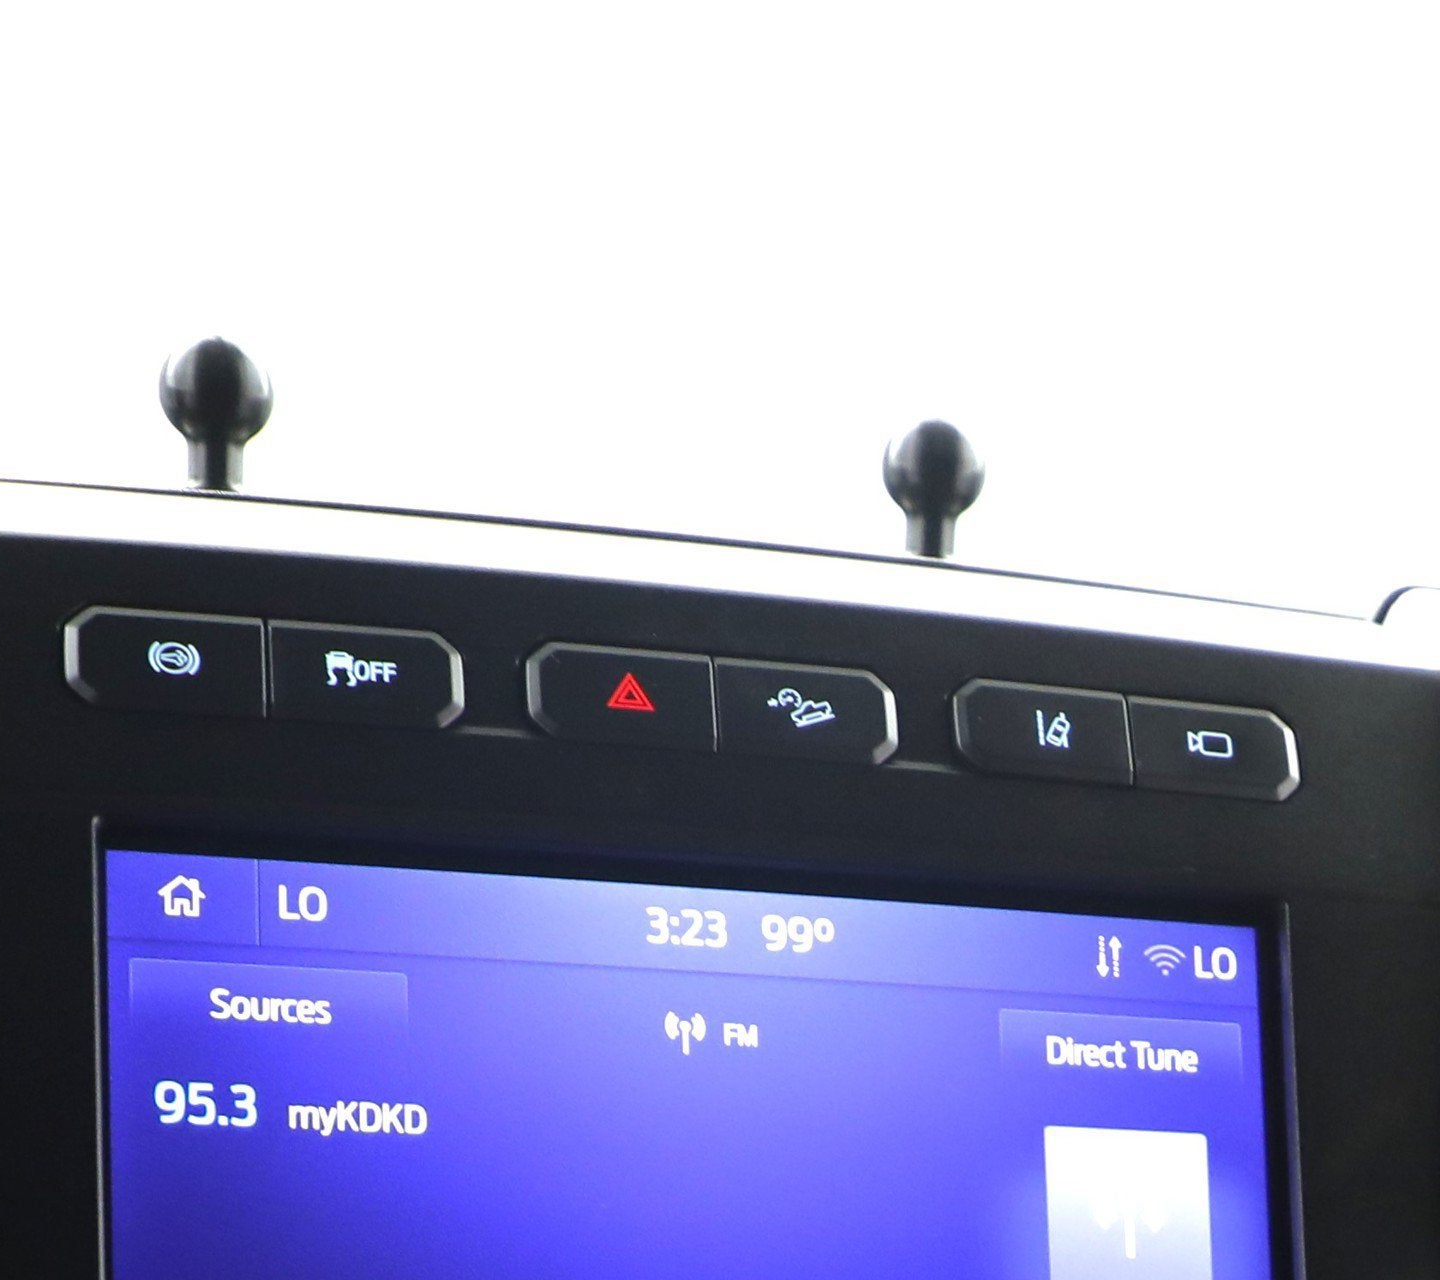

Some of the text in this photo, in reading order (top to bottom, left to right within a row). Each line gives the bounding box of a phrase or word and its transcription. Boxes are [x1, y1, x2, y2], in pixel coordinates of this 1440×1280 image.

[353, 655, 398, 684] OFF
[278, 884, 328, 922] LO
[645, 906, 728, 949] 3:23
[1193, 945, 1238, 981] LO
[209, 987, 333, 1025] Sources
[723, 1022, 759, 1048] FM
[1045, 1034, 1199, 1074] Direct Tune
[154, 1080, 428, 1137] 95.3 myKDKD
